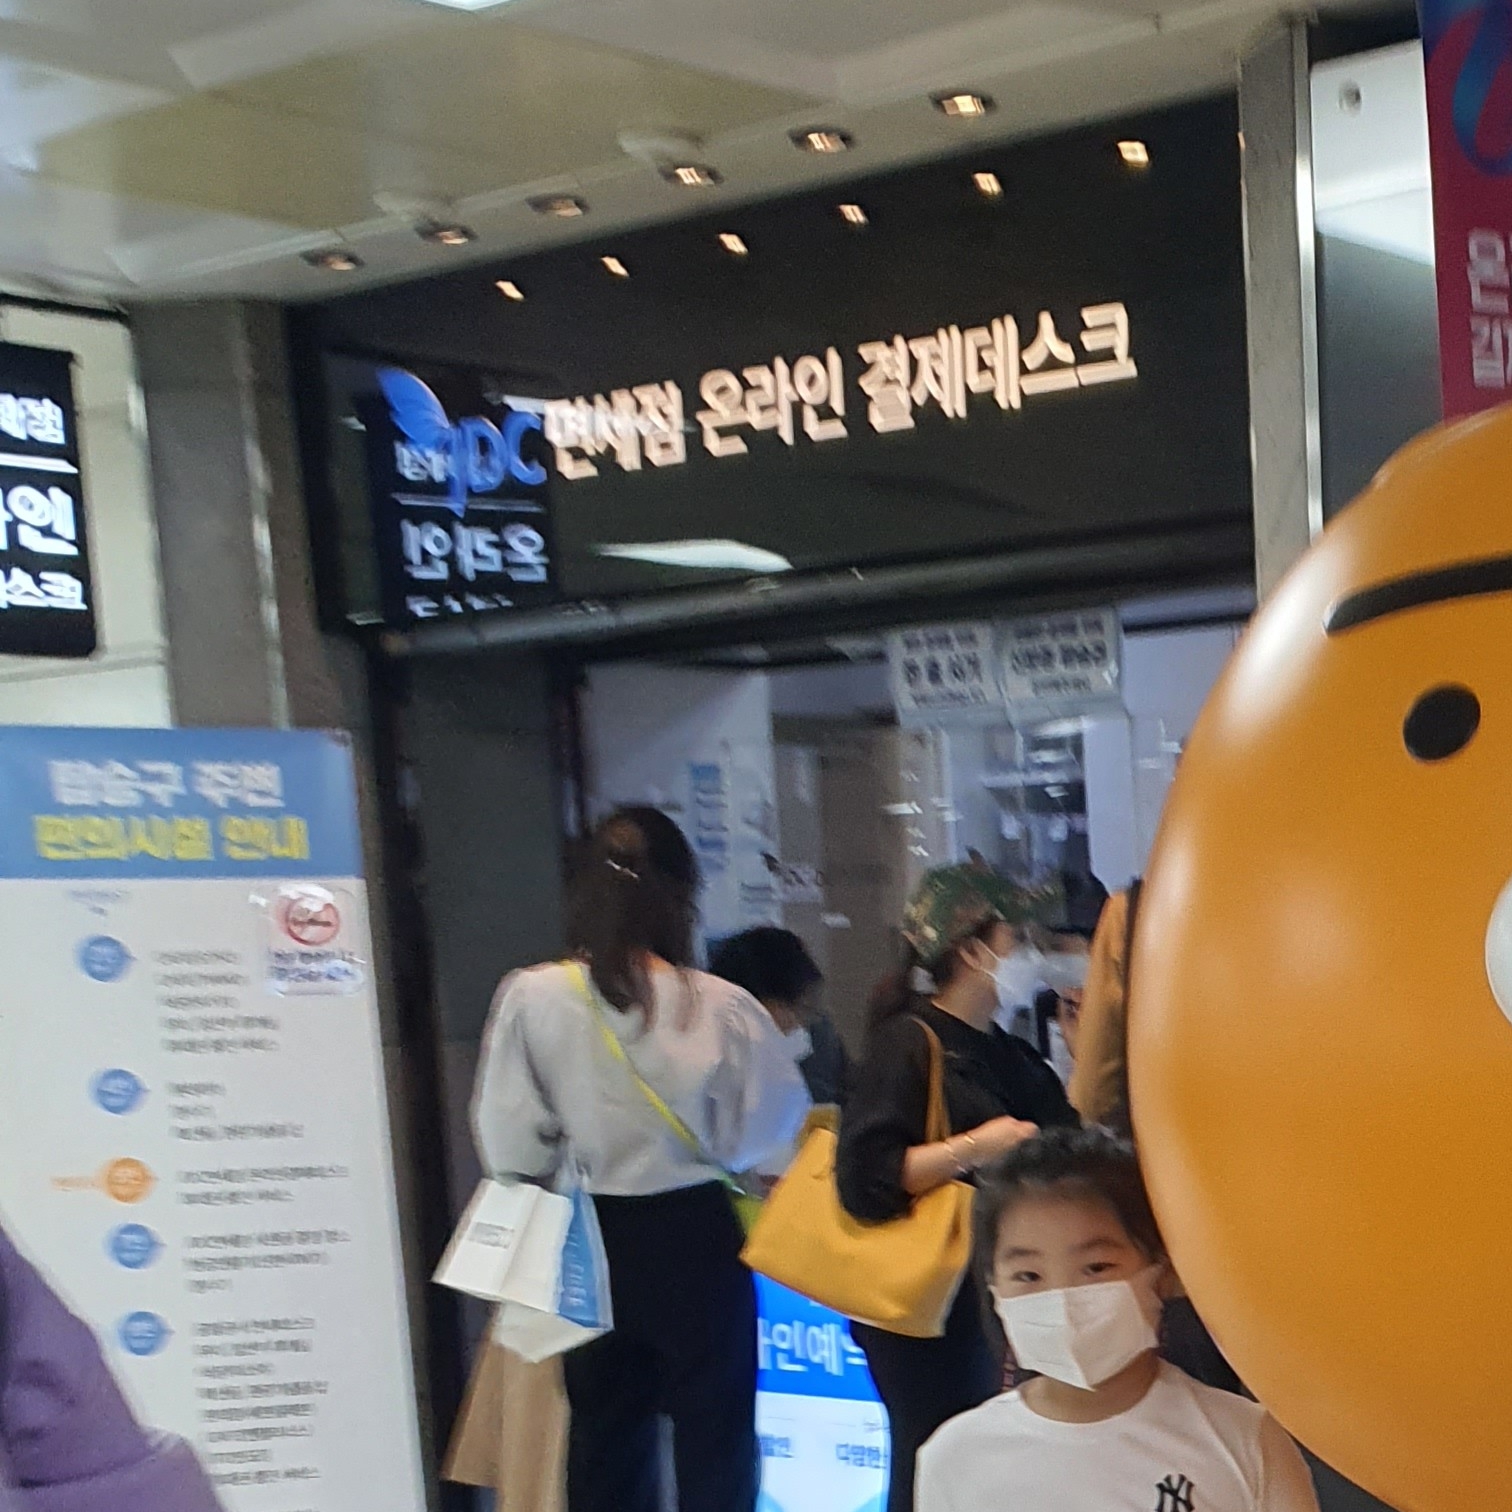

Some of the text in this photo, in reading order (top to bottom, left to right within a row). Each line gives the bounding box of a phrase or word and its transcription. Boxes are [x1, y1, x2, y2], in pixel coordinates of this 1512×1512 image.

[544, 302, 1138, 480] 면세점 온라인 결제데스크
[0, 566, 88, 610] 스크
